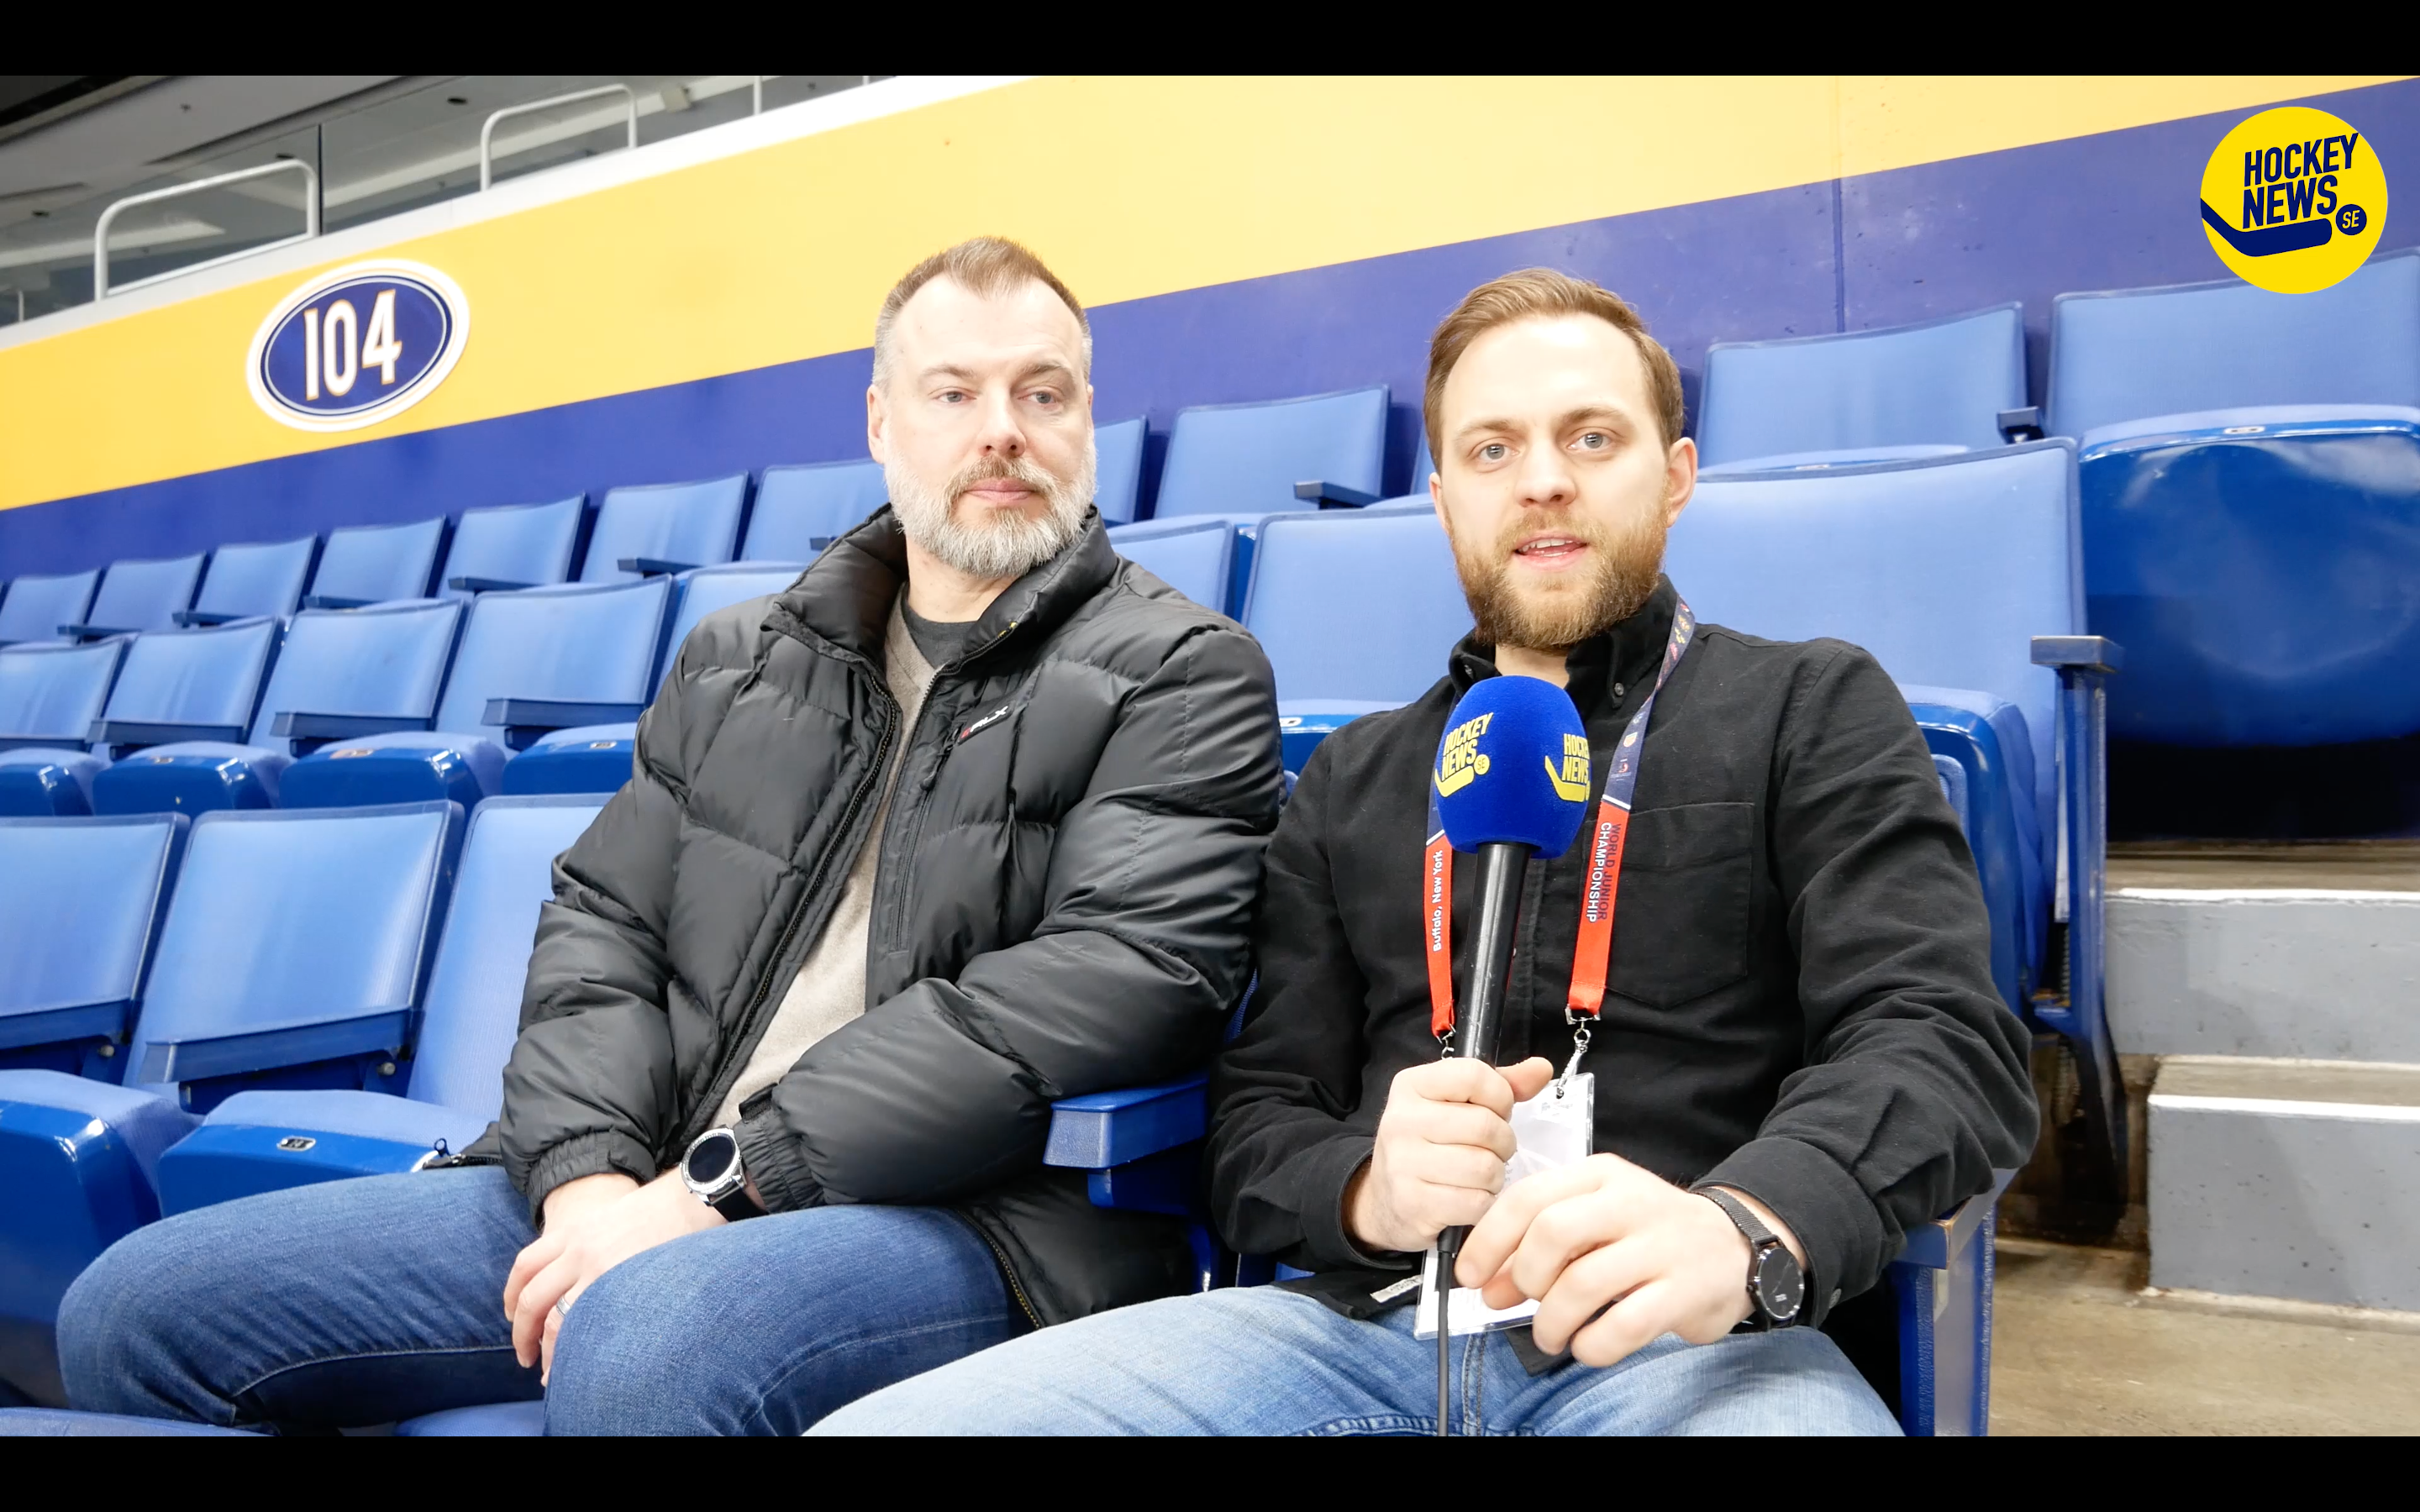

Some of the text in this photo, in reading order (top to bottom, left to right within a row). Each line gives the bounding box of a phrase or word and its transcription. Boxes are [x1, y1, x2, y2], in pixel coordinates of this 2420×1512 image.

[304, 289, 402, 401] 104
[1442, 739, 1478, 782] NEWS
[1443, 711, 1494, 757] HOCKEY
[1432, 849, 1444, 952] Buffalo, New York
[1586, 822, 1612, 923] CHAMPIONSHIP
[1597, 823, 1622, 921] WORLD JUNIOR
